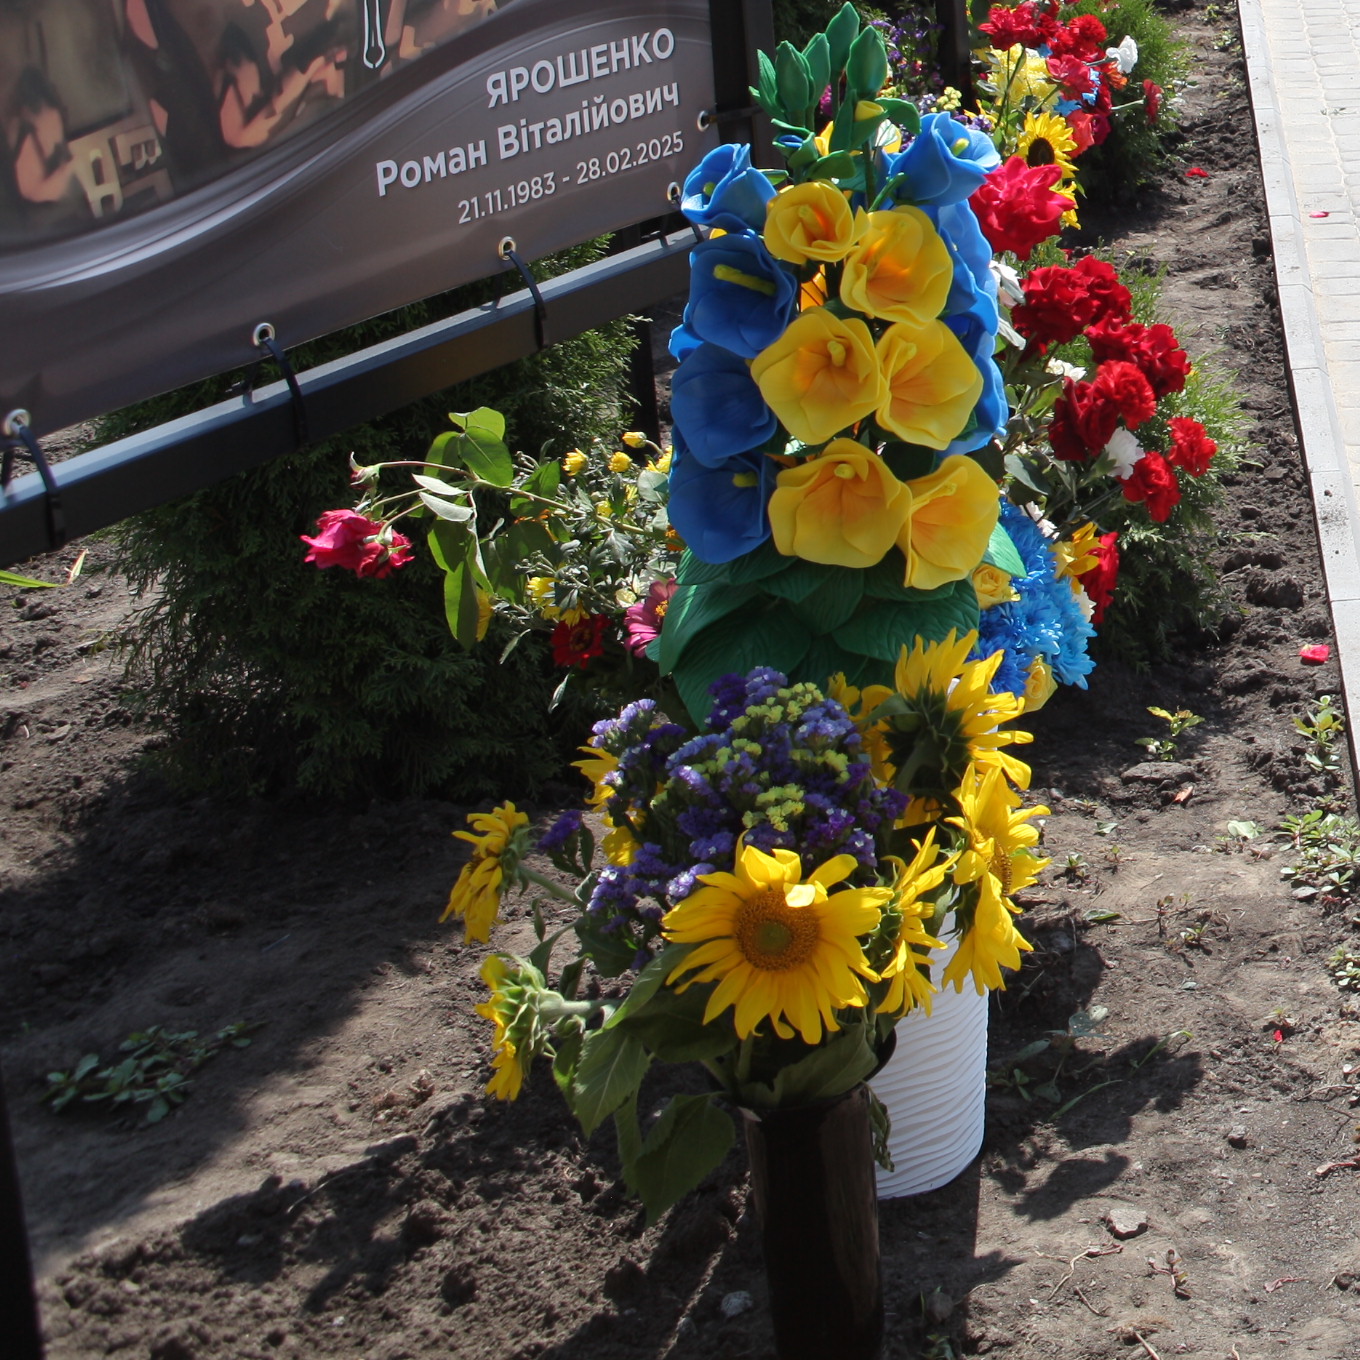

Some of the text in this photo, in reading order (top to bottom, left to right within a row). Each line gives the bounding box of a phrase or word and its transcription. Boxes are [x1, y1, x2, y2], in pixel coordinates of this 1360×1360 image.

[487, 27, 675, 109] ЯРОШЕНКО
[376, 82, 679, 197] Роман Віталійович
[457, 171, 556, 224] 21.11.1983
[576, 131, 684, 185] 28.02.2025
